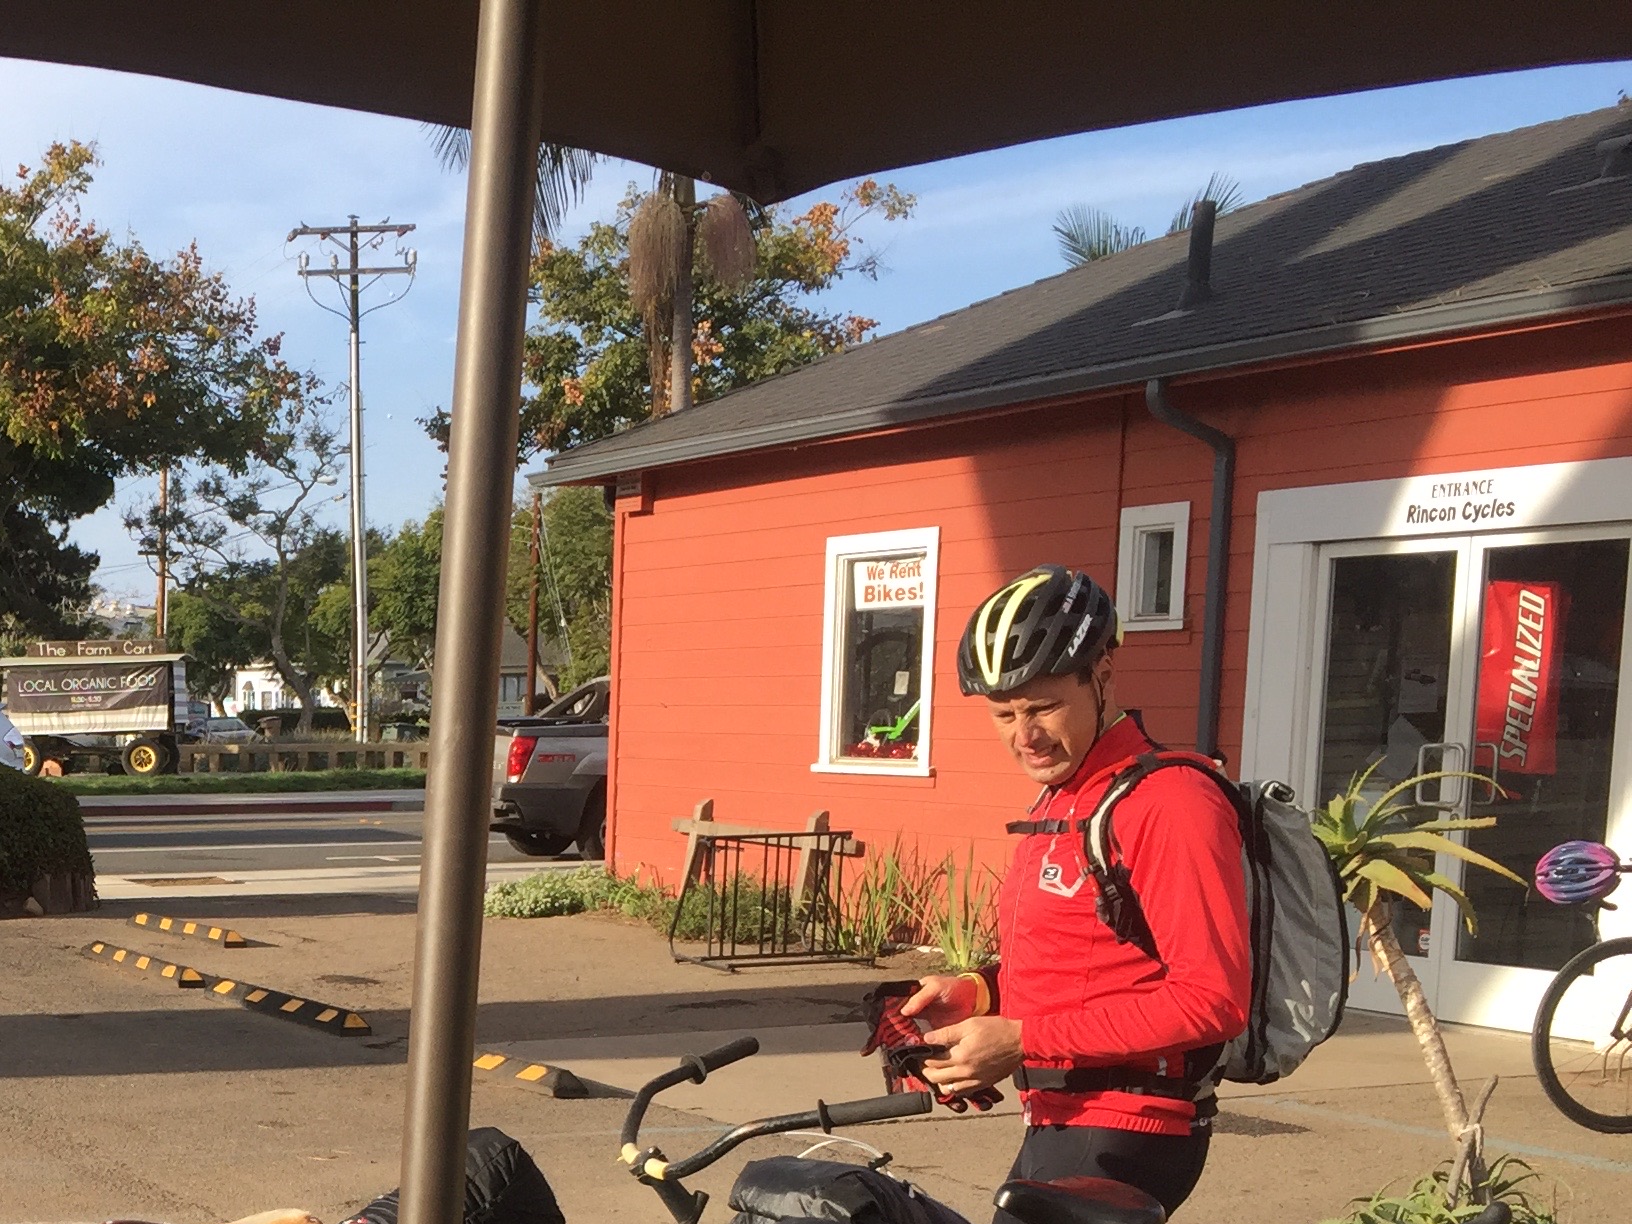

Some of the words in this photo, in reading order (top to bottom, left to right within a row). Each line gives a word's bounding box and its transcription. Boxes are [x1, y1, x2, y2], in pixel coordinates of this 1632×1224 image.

[1431, 479, 1494, 498] ENTRANCE
[1406, 504, 1456, 524] Rincon
[1462, 499, 1515, 523] Cycles
[867, 565, 885, 581] We
[889, 561, 921, 579] Rent
[864, 581, 924, 603] Bikes!
[36, 642, 66, 657] The
[77, 641, 112, 656] Farm
[123, 641, 153, 655] Cart
[18, 679, 58, 693] LOCAL
[61, 677, 117, 691] ORGANIC
[120, 674, 156, 688] FOOD
[1499, 589, 1546, 767] SPECIALIZED
